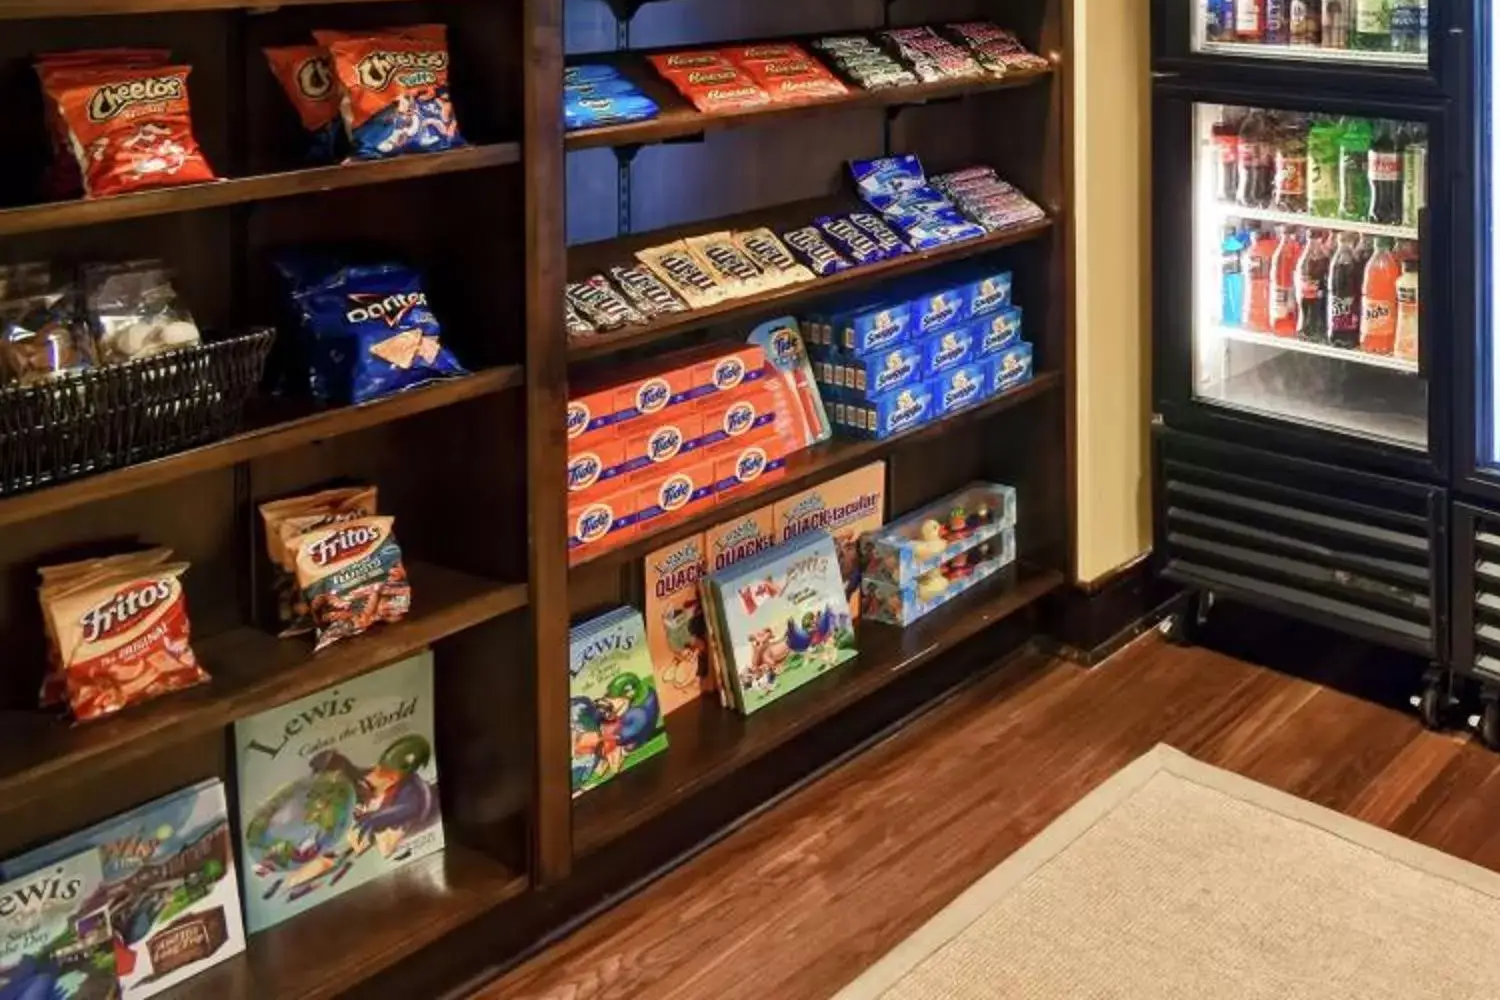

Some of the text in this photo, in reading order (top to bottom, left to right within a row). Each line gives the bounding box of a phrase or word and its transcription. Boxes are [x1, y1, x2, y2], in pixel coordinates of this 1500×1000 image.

[359, 51, 446, 91] Cheetos
[89, 77, 180, 121] Cheetos
[346, 292, 429, 324] Doritos
[717, 363, 743, 386] Tide
[638, 385, 669, 409] Tide
[727, 408, 753, 431] Tide
[652, 432, 681, 456] Tide
[568, 460, 599, 485] Tide
[739, 455, 765, 477] Tide
[662, 481, 692, 506] Tide
[580, 510, 610, 536] Tide
[307, 525, 380, 566] Fritos
[79, 578, 171, 645] Fritos
[248, 690, 357, 760] Lewis
[359, 696, 419, 735] World
[0, 867, 82, 916] ewis
